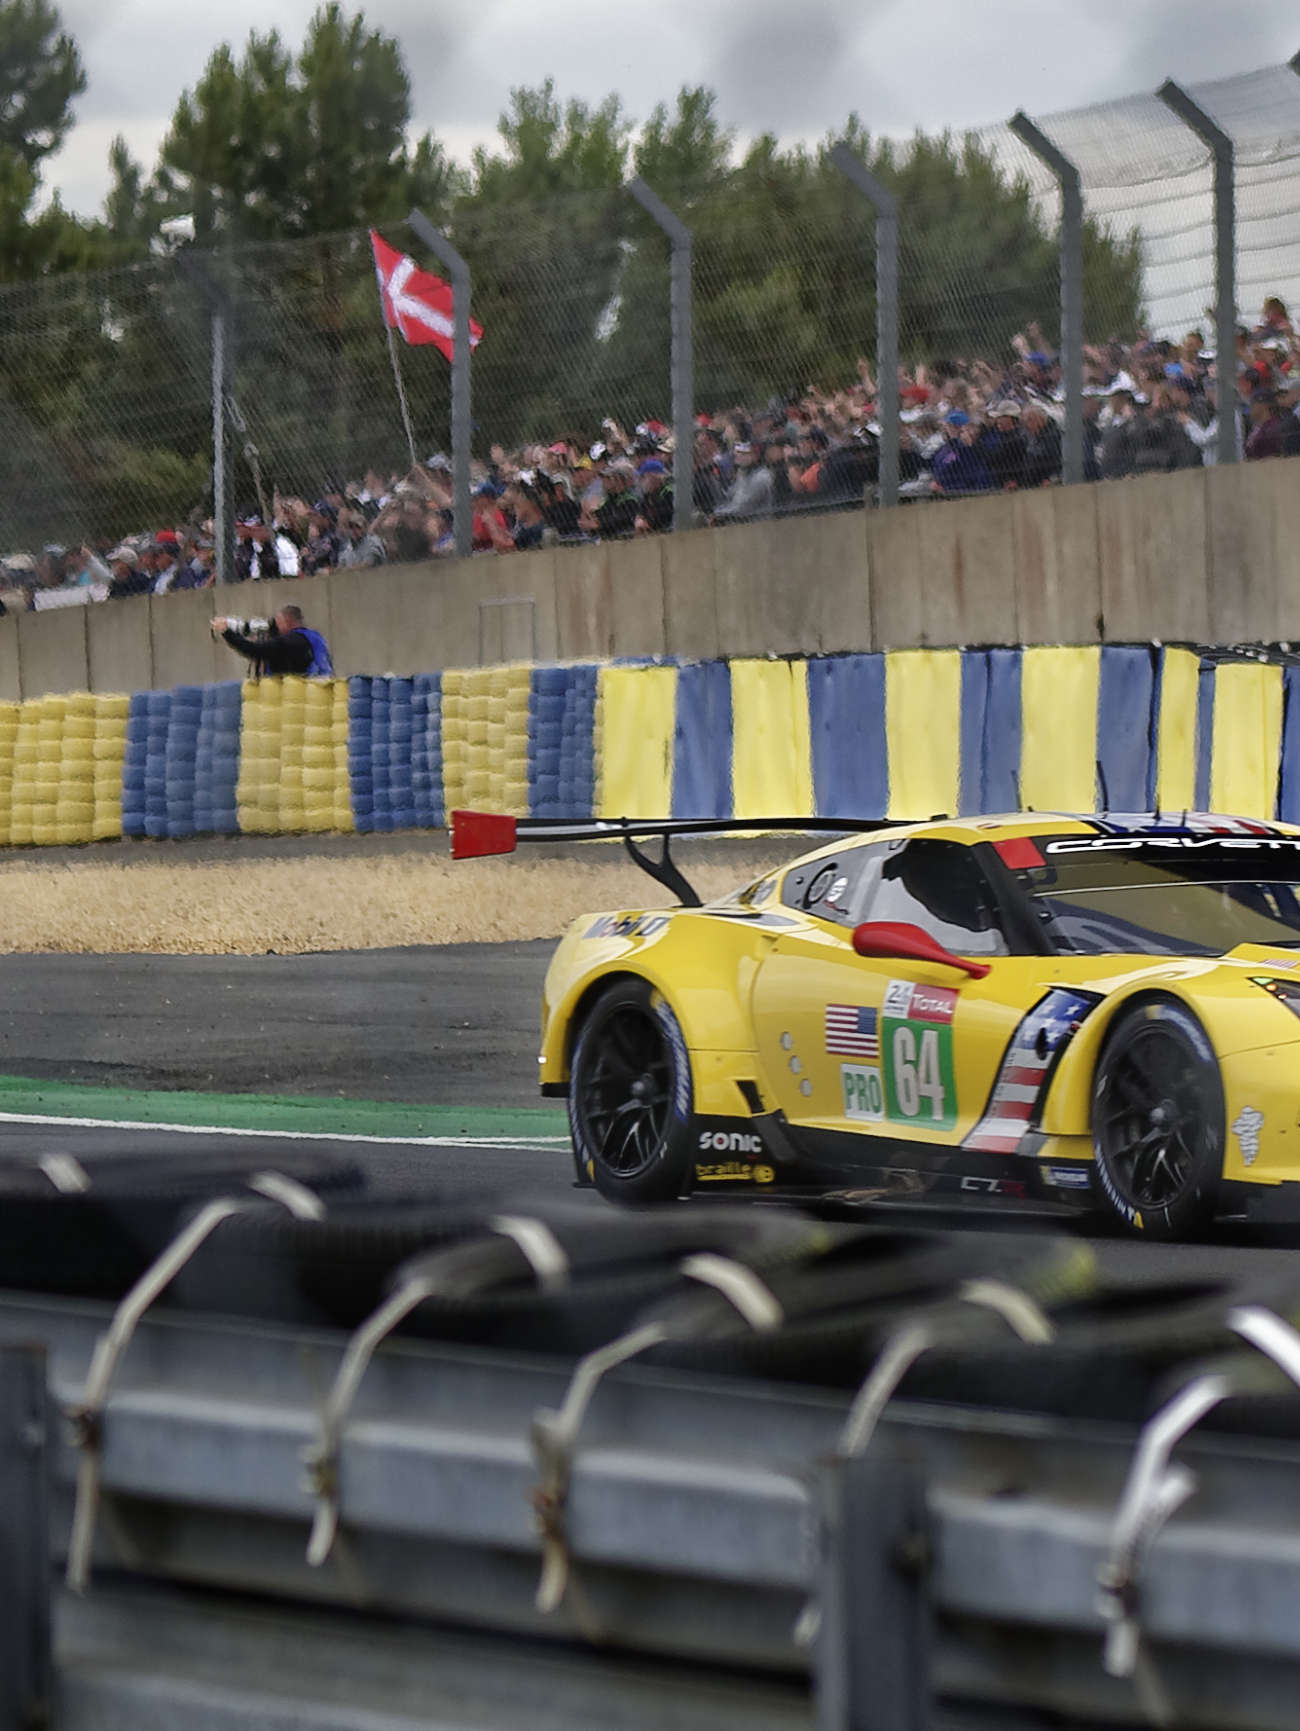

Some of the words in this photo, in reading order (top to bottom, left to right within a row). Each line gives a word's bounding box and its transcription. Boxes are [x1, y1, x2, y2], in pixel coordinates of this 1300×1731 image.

[911, 993, 954, 1014] TOTAL
[844, 1071, 883, 1114] PRO
[892, 1026, 945, 1121] 64
